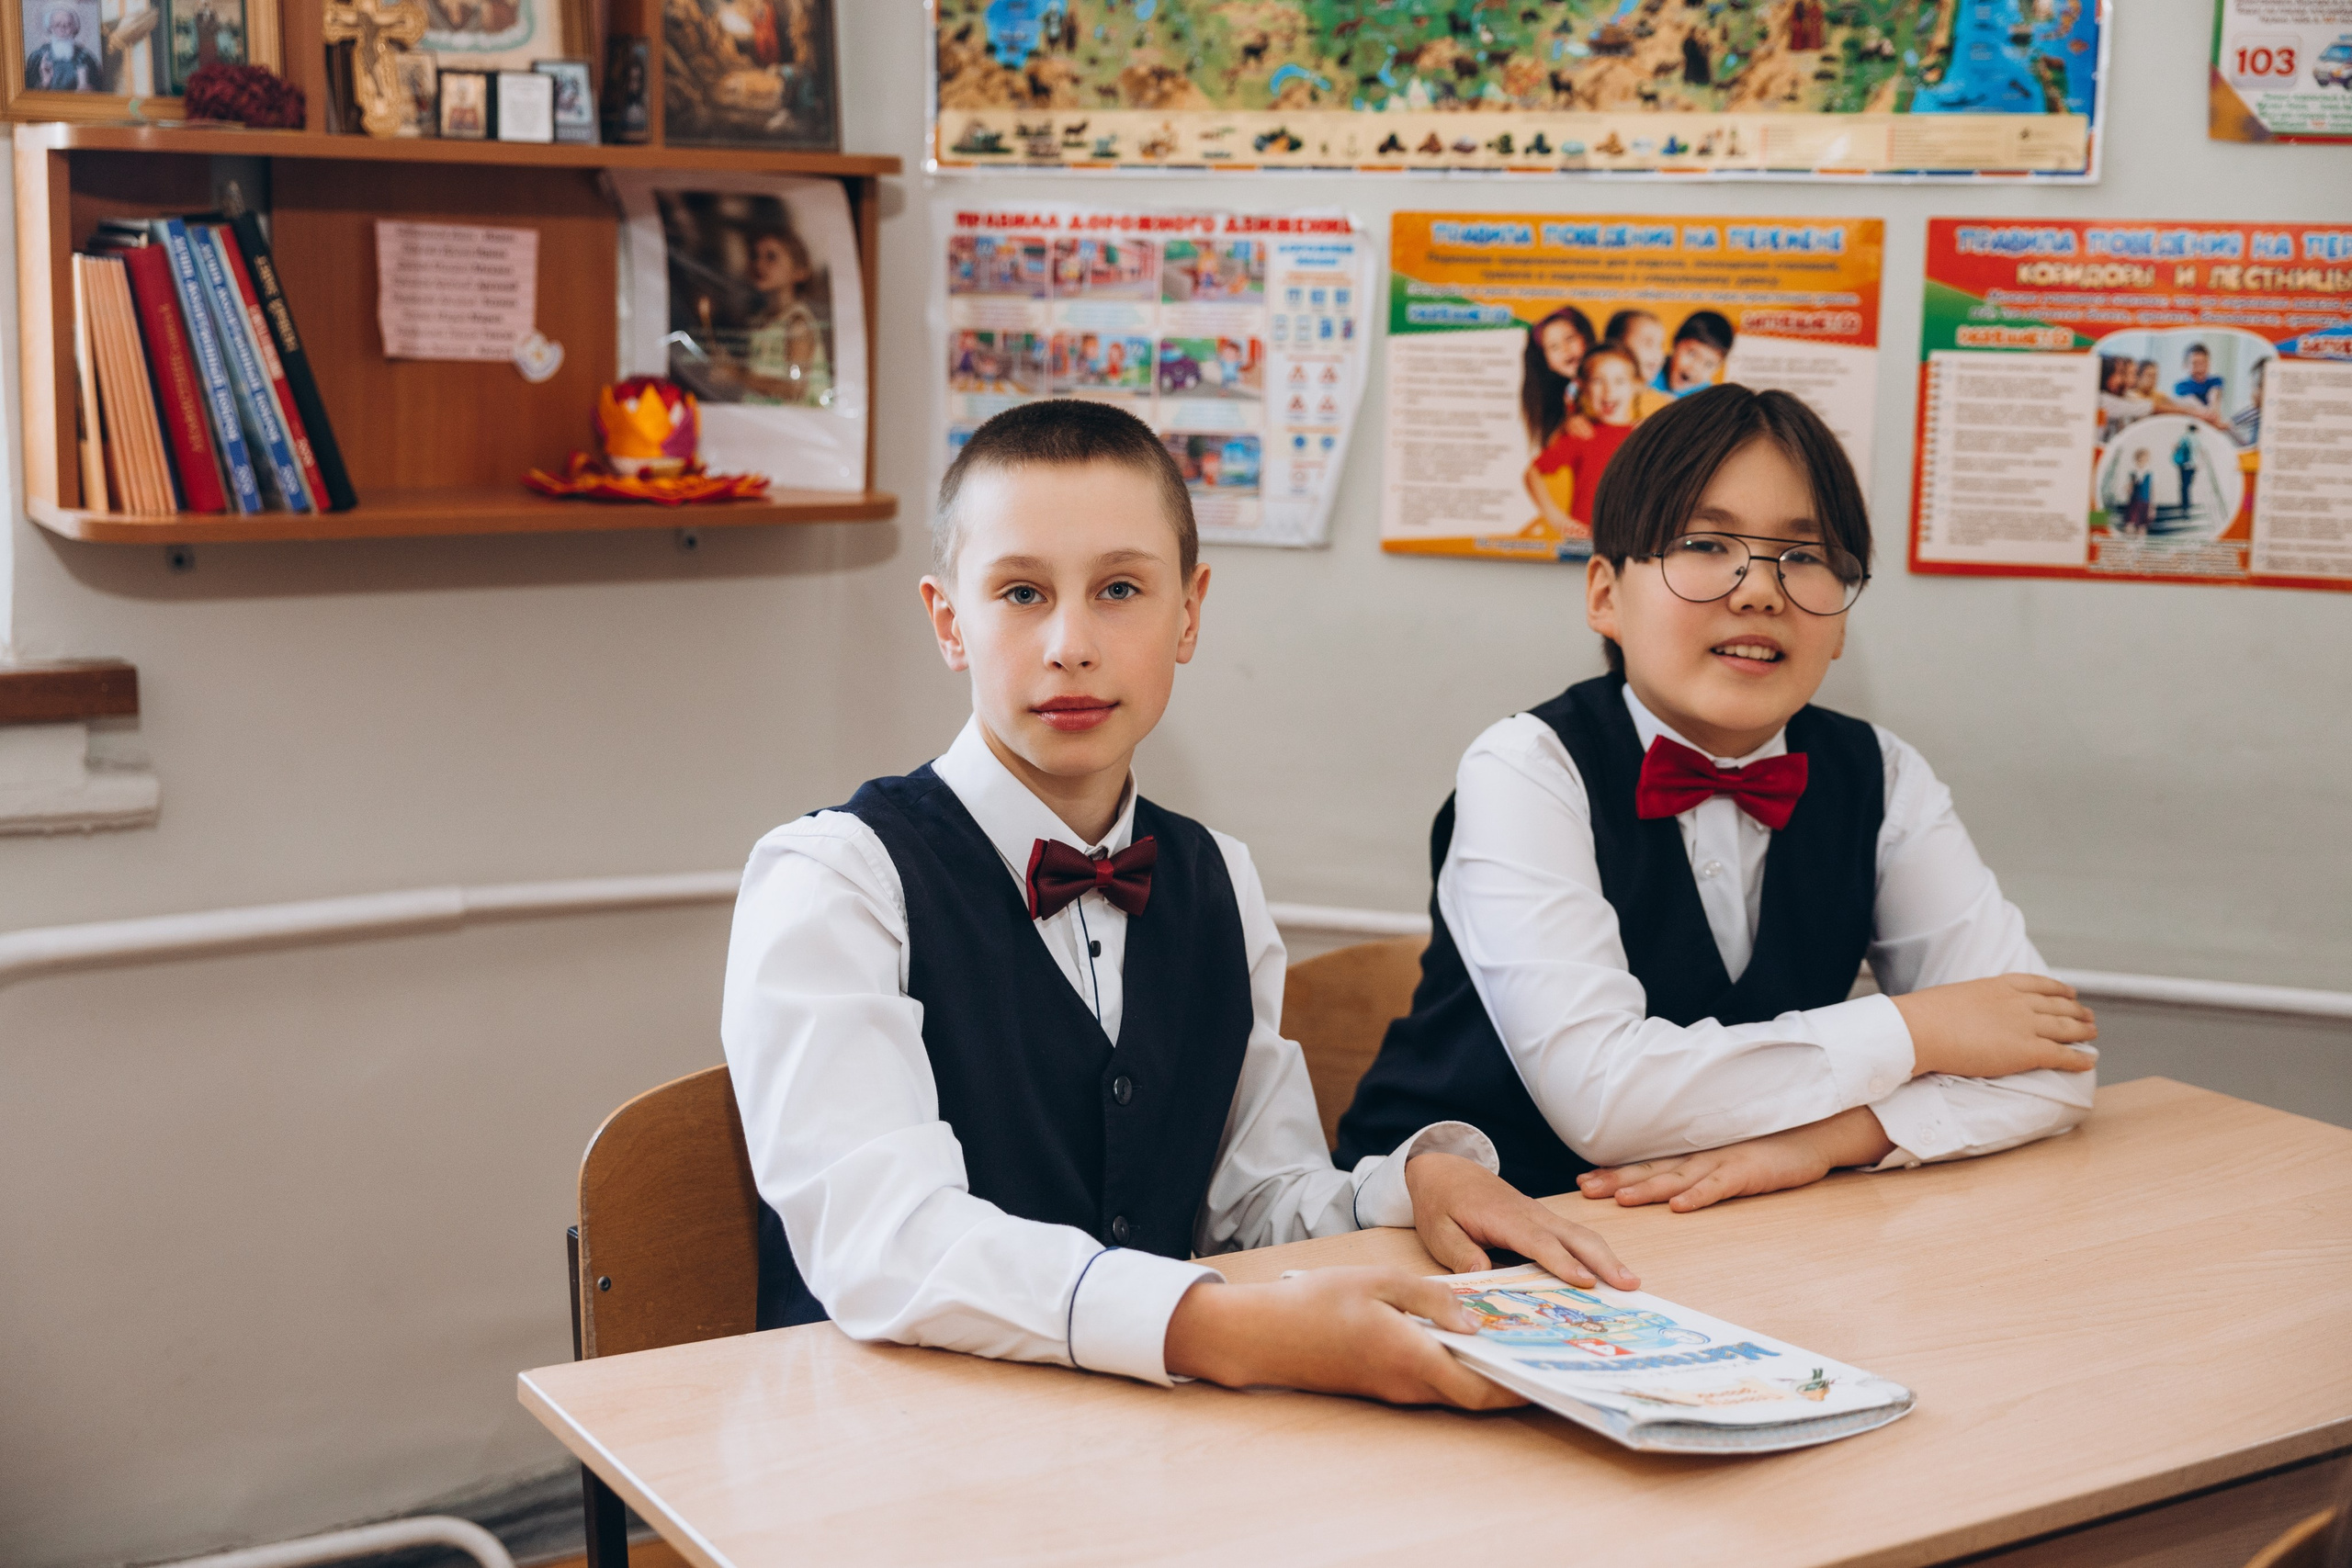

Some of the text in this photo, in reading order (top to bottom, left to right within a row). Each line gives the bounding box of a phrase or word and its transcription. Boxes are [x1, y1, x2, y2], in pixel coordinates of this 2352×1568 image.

[2236, 47, 2295, 75] 103
[956, 212, 1058, 229] ПРАВИЛА
[1068, 215, 1214, 231] ДОРОЖНОГО
[1432, 221, 1845, 254] ПРАВИЛА ПОВЕДЕНИЯ НА ПЕРЕМЕНЕ
[1957, 228, 2075, 255] ПРАВИЛА
[2086, 230, 2242, 261] ПОВЕДЕНИЯ
[2252, 232, 2292, 260] НА
[2017, 262, 2154, 288] КОРИДОРЫ
[2174, 265, 2196, 288] И
[1511, 1340, 1782, 1371] Математика
